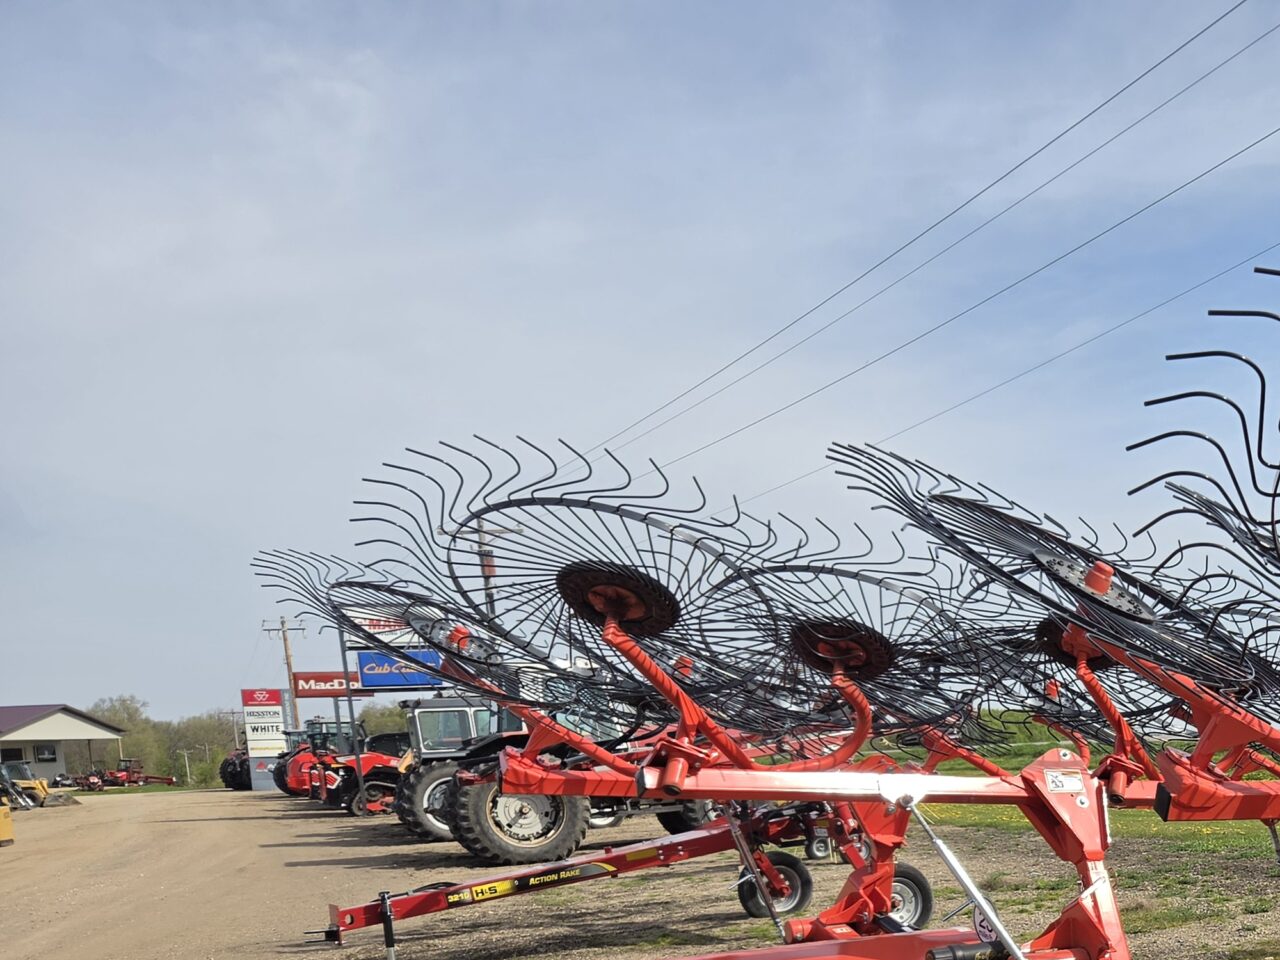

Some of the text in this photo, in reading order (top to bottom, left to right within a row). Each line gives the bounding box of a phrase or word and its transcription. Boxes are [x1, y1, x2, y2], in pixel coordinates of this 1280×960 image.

[298, 679, 359, 690] MacDo
[250, 725, 281, 733] WHITE
[529, 869, 581, 885] ACTION RAKE
